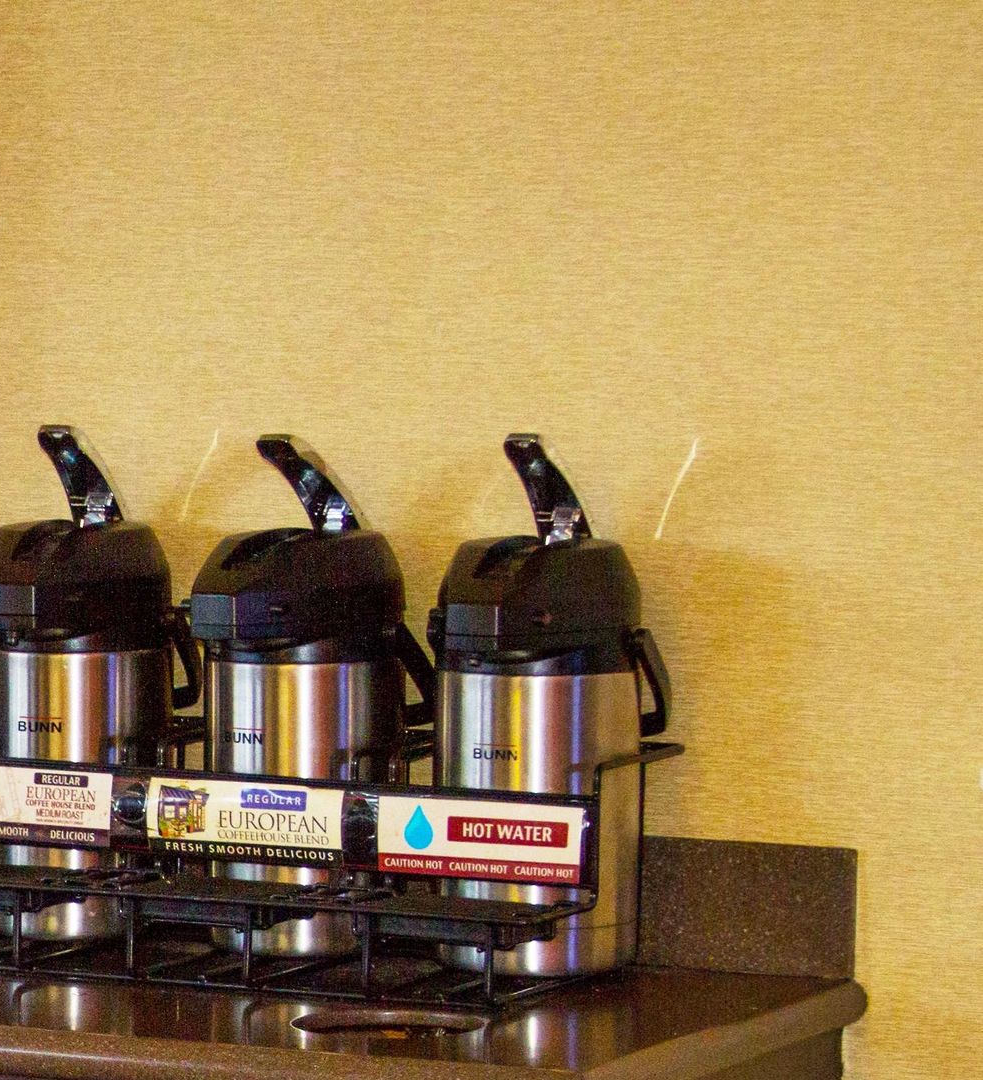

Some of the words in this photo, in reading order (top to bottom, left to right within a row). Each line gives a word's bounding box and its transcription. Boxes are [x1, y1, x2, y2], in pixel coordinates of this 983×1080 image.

[18, 720, 62, 733] BUNN
[224, 731, 263, 745] BUNN
[473, 747, 518, 761] BUNN
[41, 774, 81, 787] REGULAR
[26, 786, 96, 803] EUROPEAN
[246, 793, 302, 806] REGULAR
[25, 799, 49, 808] COFFEE
[51, 801, 72, 810] HOUSE
[74, 802, 96, 811] BLEND
[36, 808, 61, 819] MEDIUM
[61, 810, 84, 821] ROAST
[218, 810, 328, 834] EUROPEAN
[50, 829, 95, 842] DELICIOUS
[217, 829, 292, 844] COFFEEHOUSE
[294, 834, 329, 846] BLEND
[462, 821, 493, 840] HOT
[497, 823, 552, 842] WATER
[166, 841, 204, 853] FRESH
[209, 845, 262, 857] SMOOTH
[267, 848, 334, 862] DELICIOUS
[384, 857, 424, 868] CAUTION
[425, 860, 443, 870] HOT
[449, 861, 489, 873] CAUTION
[490, 864, 507, 875] HOT
[514, 865, 554, 877] CAUTION
[556, 868, 574, 878] HOT
